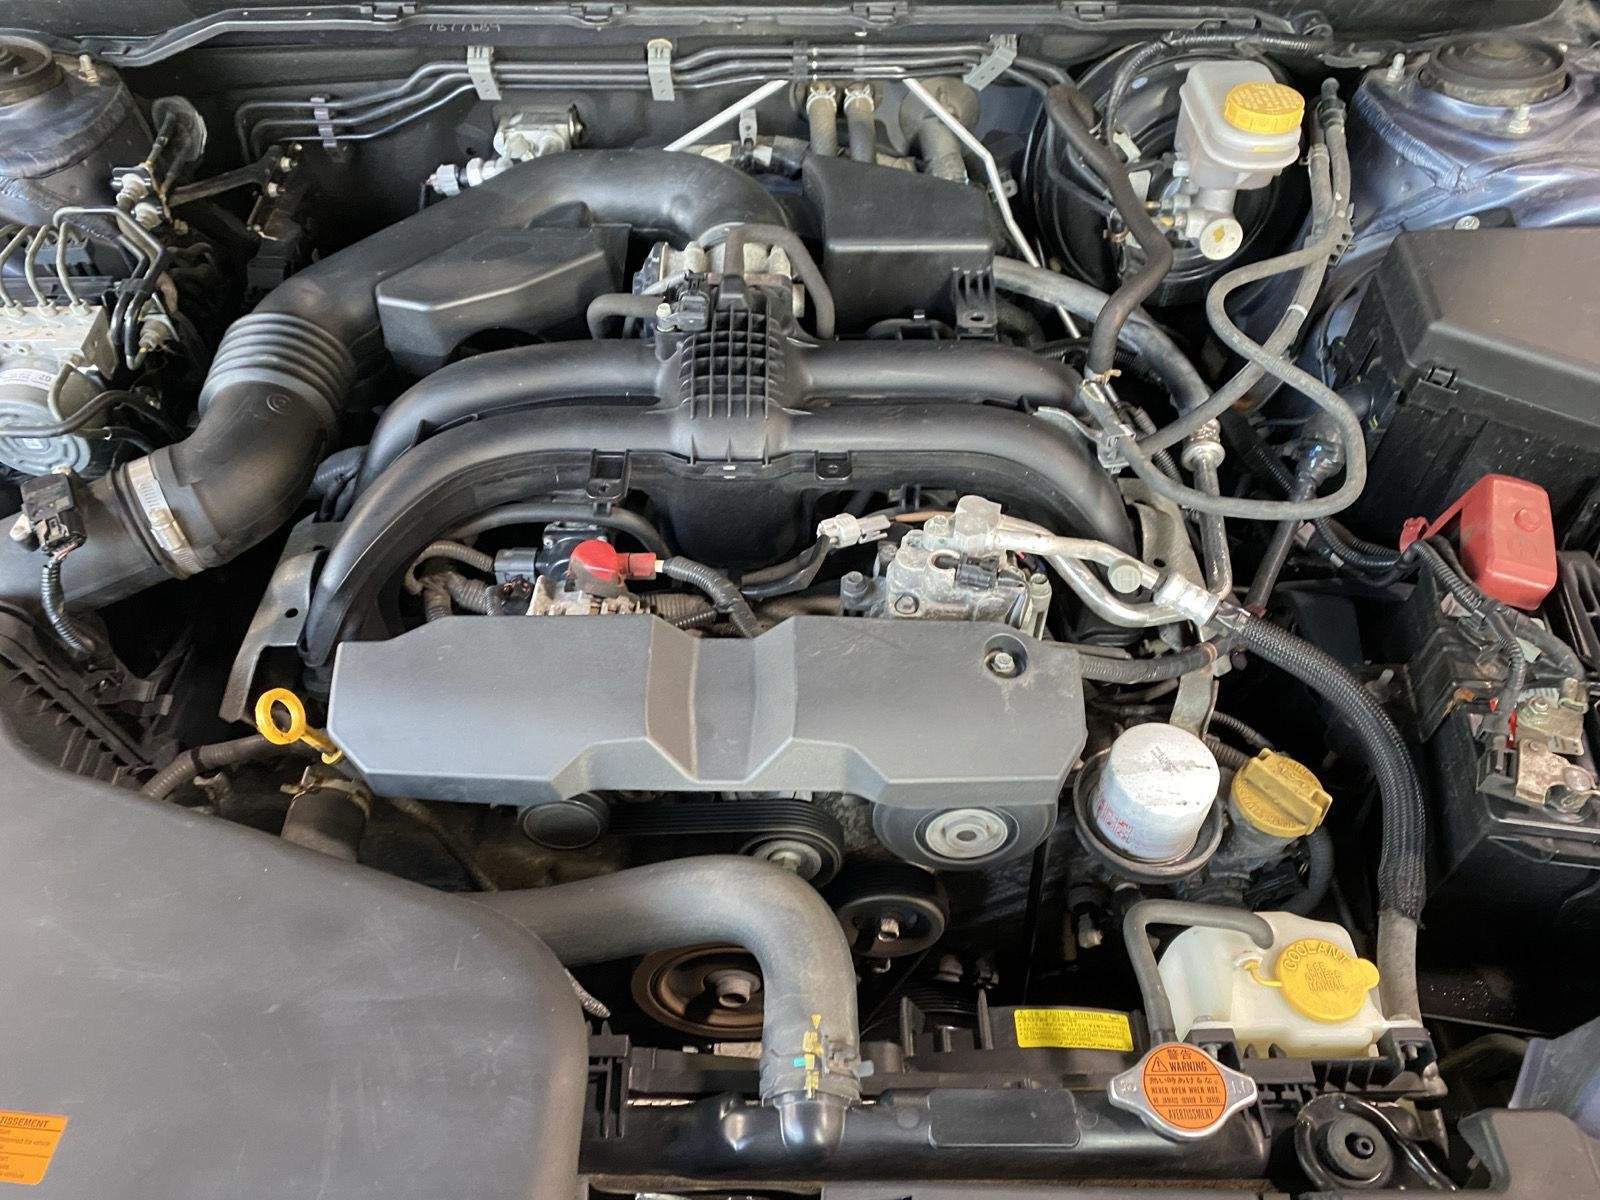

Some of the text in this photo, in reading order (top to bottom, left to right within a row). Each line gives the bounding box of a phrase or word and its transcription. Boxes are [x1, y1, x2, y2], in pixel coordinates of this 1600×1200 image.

[1283, 941, 1350, 970] COOLANT
[1169, 1061, 1207, 1073] WARNING
[1171, 1086, 1187, 1094] OPEN
[1189, 1086, 1205, 1094] WHEN
